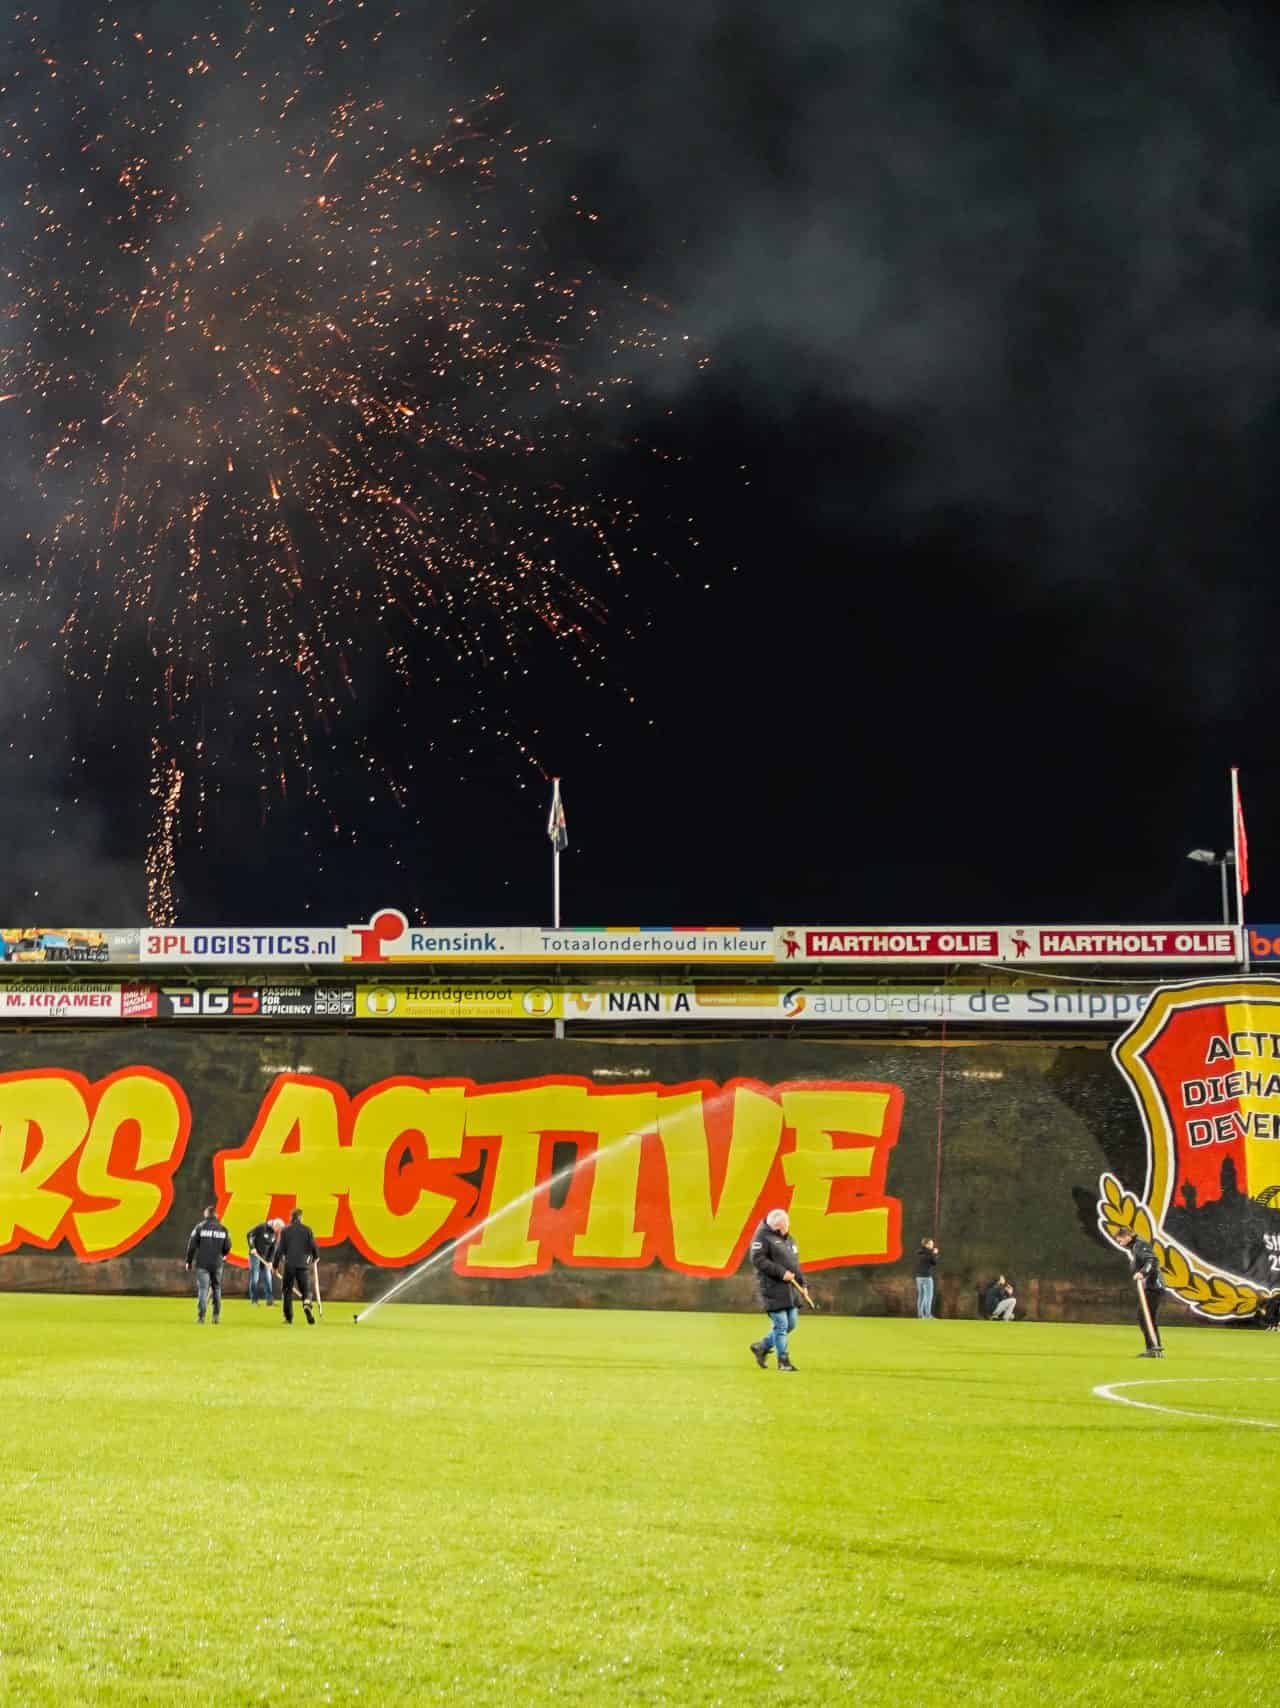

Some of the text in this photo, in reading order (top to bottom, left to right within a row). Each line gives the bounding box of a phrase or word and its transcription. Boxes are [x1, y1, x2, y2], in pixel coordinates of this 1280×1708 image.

[148, 935, 336, 955] 3PLOGISTICS.nl
[541, 937, 768, 951] Totaalonderhoud in kleur
[812, 935, 992, 951] HARTHOLT OLIE
[1043, 935, 1231, 952] HARTHOLT OLIE
[262, 988, 301, 997] PASSION
[6, 995, 26, 1007] M.
[29, 995, 112, 1007] KRAMER
[262, 997, 280, 1005] FOR
[813, 992, 953, 1016] autobedrijf
[969, 990, 1010, 1012] de
[262, 1005, 312, 1015] EFFICIENCY
[213, 1073, 904, 1278] ACTIVE
